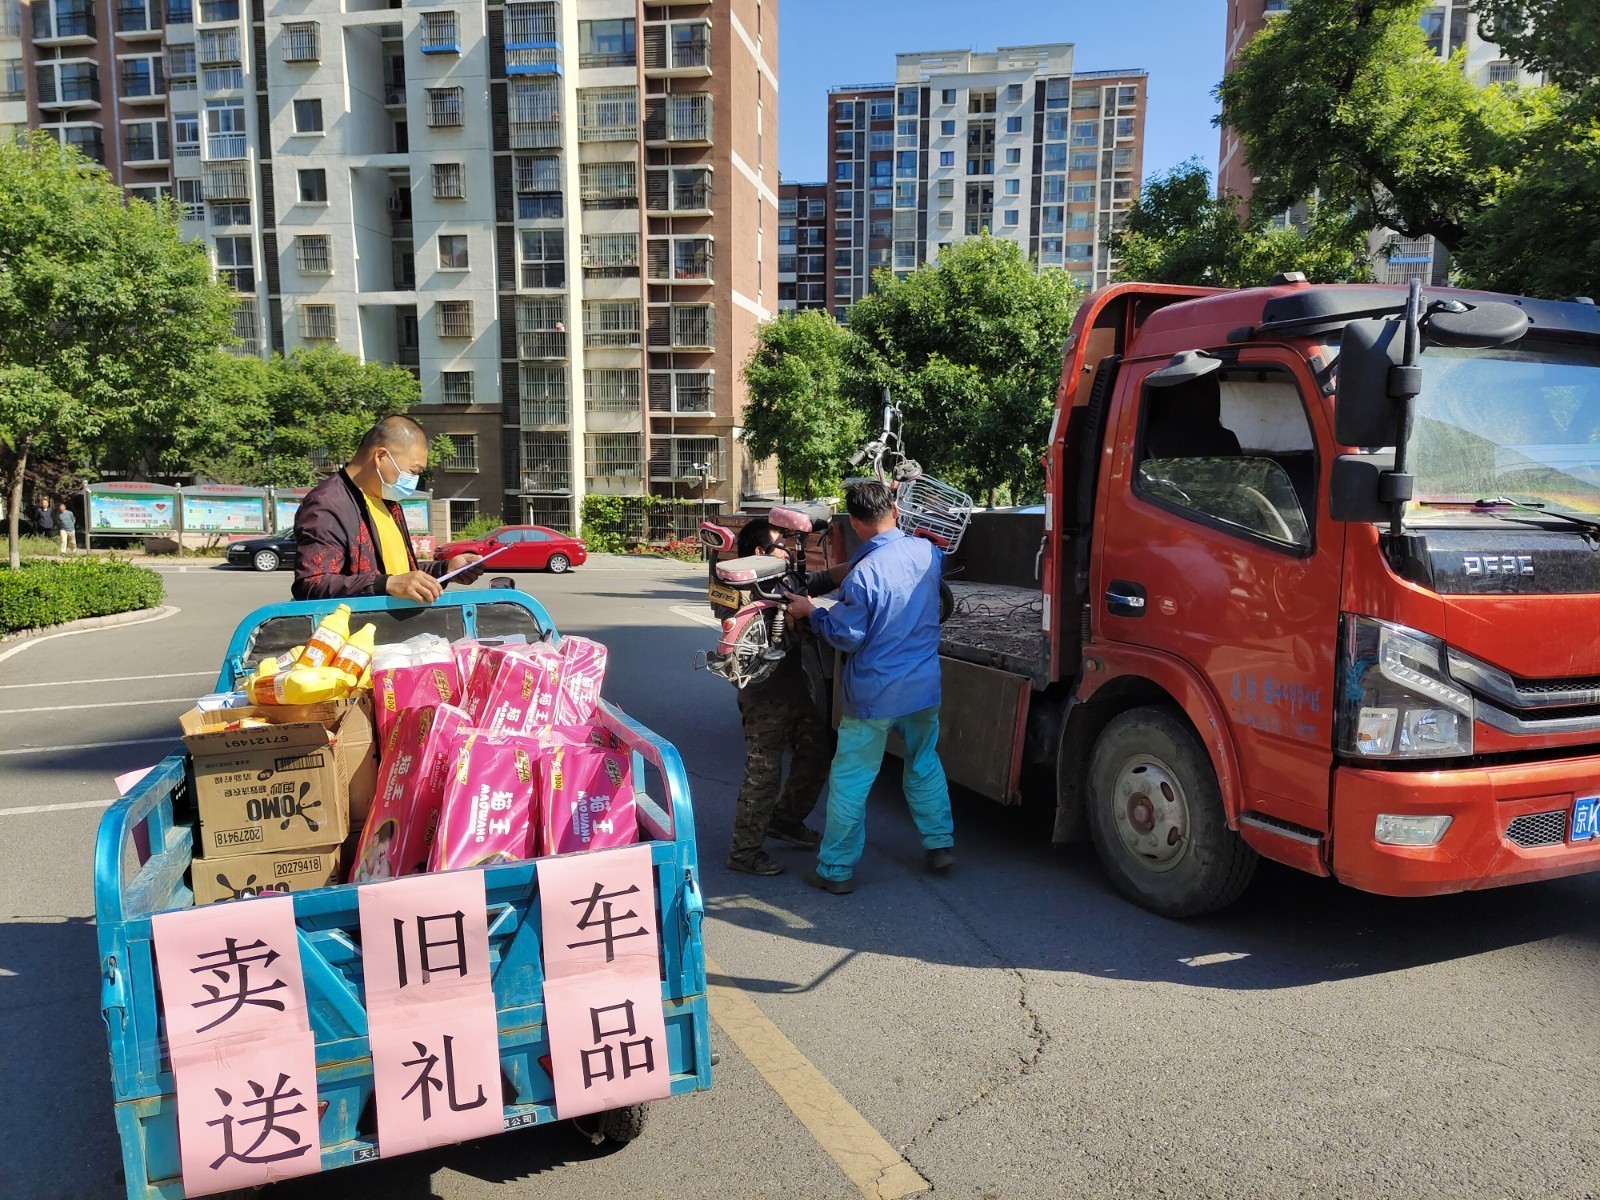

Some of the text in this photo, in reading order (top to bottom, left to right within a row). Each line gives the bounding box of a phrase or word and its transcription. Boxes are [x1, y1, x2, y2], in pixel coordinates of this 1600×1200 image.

[225, 735, 289, 748] 67121491
[391, 755, 412, 801] 猫王
[246, 795, 296, 821] OMO
[475, 784, 491, 842] MAOWANG
[489, 791, 514, 835] 猫王
[577, 791, 591, 843] MAOWANG
[589, 795, 614, 835] 猫王
[217, 829, 260, 845] 20279418
[276, 859, 319, 875] 20279418
